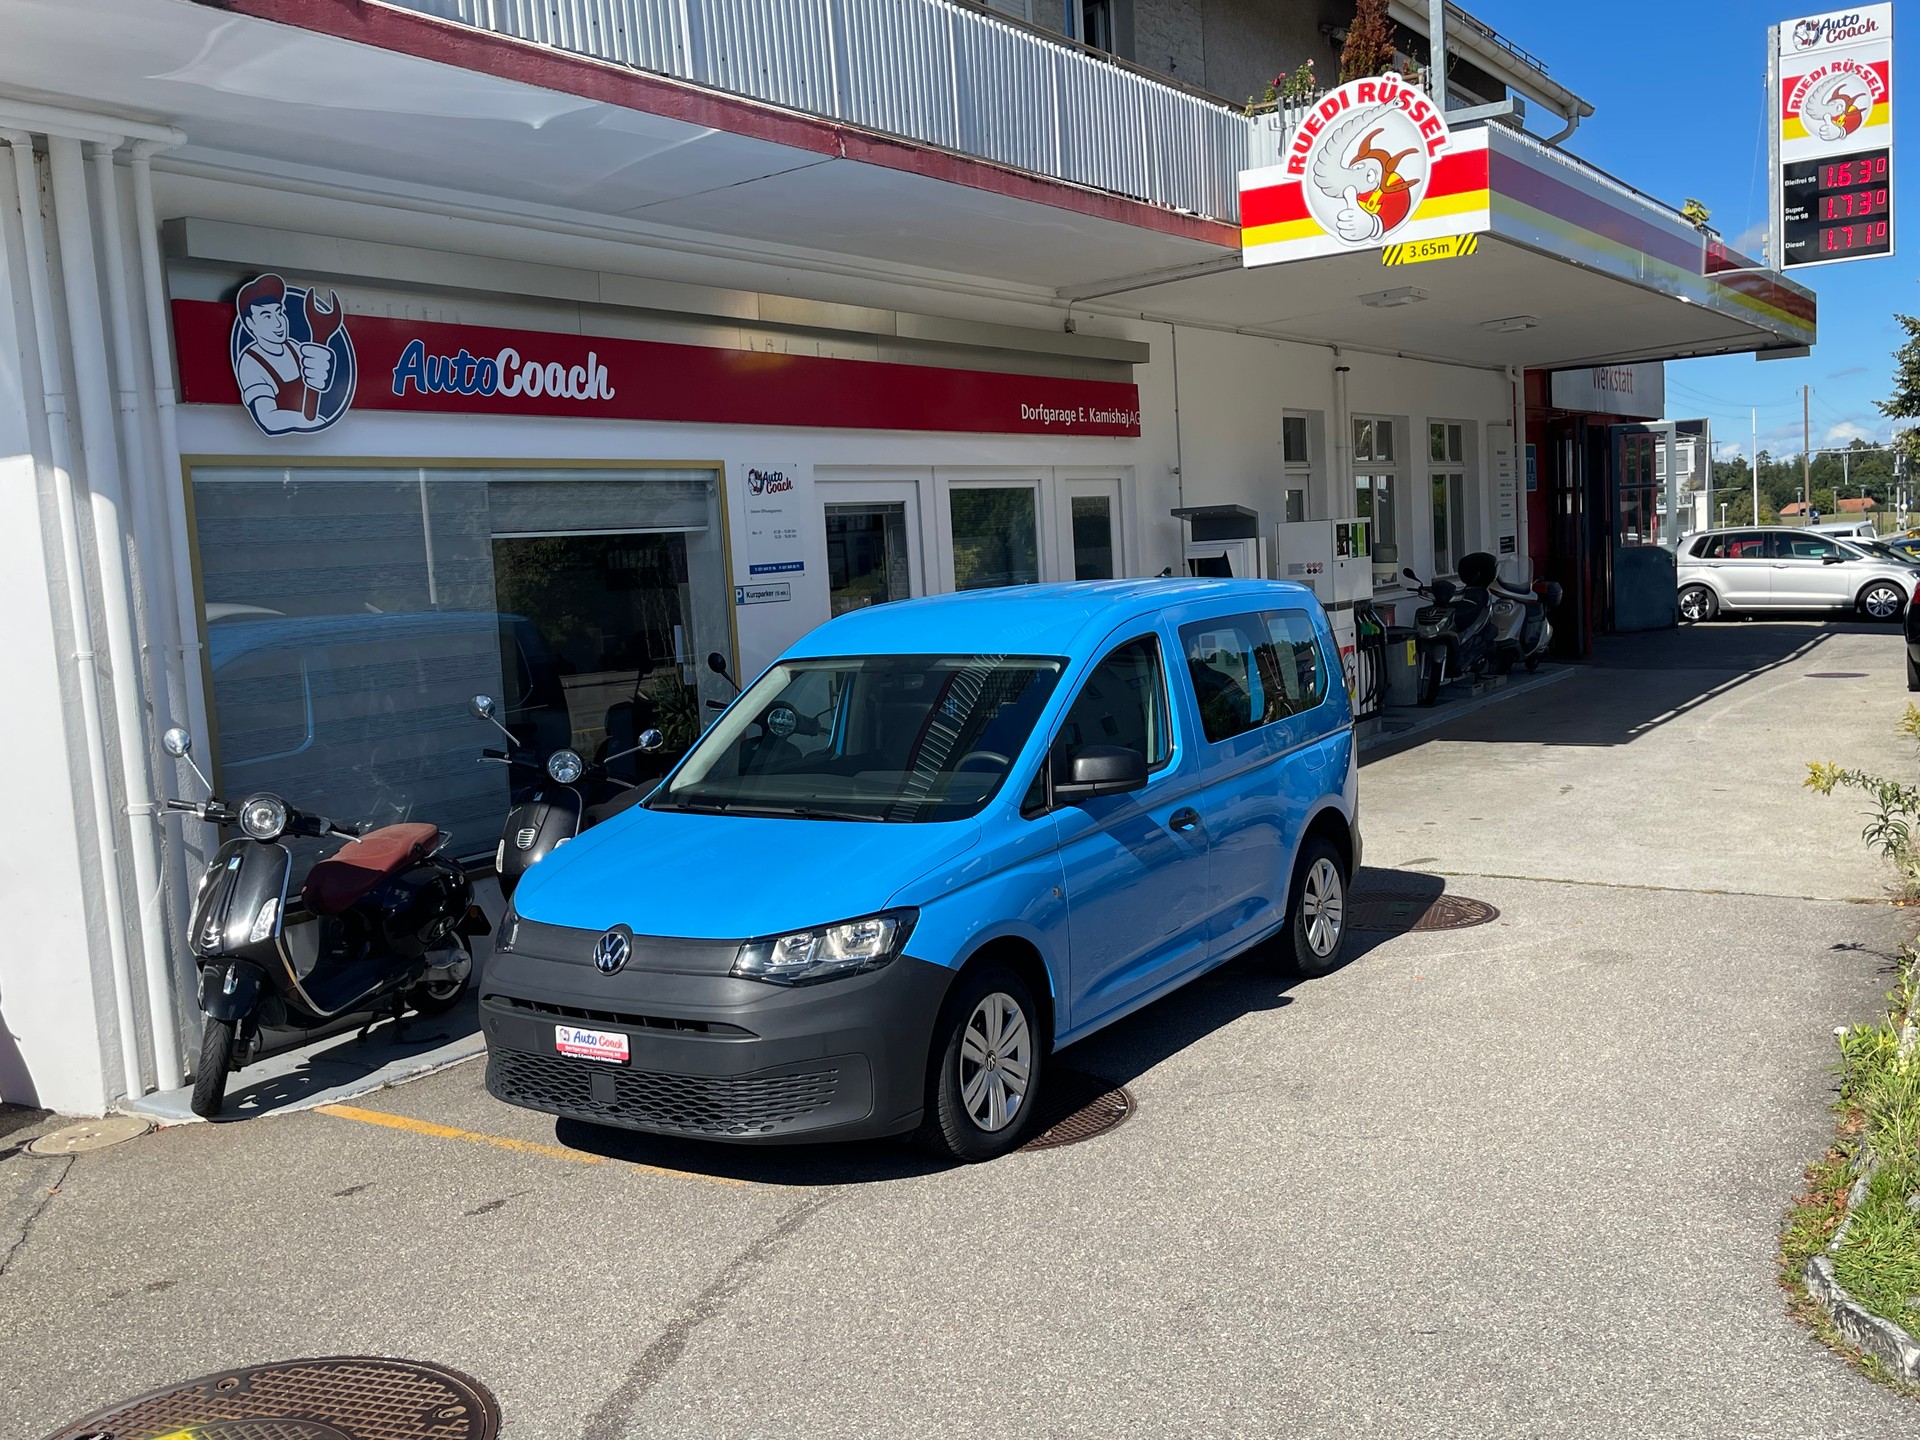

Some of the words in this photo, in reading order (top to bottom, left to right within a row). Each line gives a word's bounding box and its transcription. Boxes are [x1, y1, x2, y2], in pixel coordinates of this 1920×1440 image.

[1820, 14, 1859, 35] Auto
[1826, 18, 1878, 44] Coach
[1790, 66, 1827, 110] RUEDI
[1831, 58, 1883, 99] RÜSSEL
[1287, 89, 1351, 176] RUEDI
[1357, 75, 1448, 157] RÜSSEL
[1785, 206, 1805, 215] Super
[1785, 214, 1800, 222] Plus
[1408, 243, 1450, 259] 3.65m
[1784, 240, 1806, 249] Diesel
[392, 339, 616, 402] AutoCoach
[1592, 366, 1633, 394] Werkstatt
[1020, 403, 1077, 426] Dorfgarage
[1078, 406, 1087, 423] E.
[1089, 407, 1129, 428] Kamishaj
[1129, 411, 1141, 425] AG
[762, 470, 783, 484] Auto
[766, 477, 793, 495] Coach
[746, 589, 774, 600] Kurzparker
[573, 1030, 597, 1046] Auto
[598, 1034, 624, 1049] Coach
